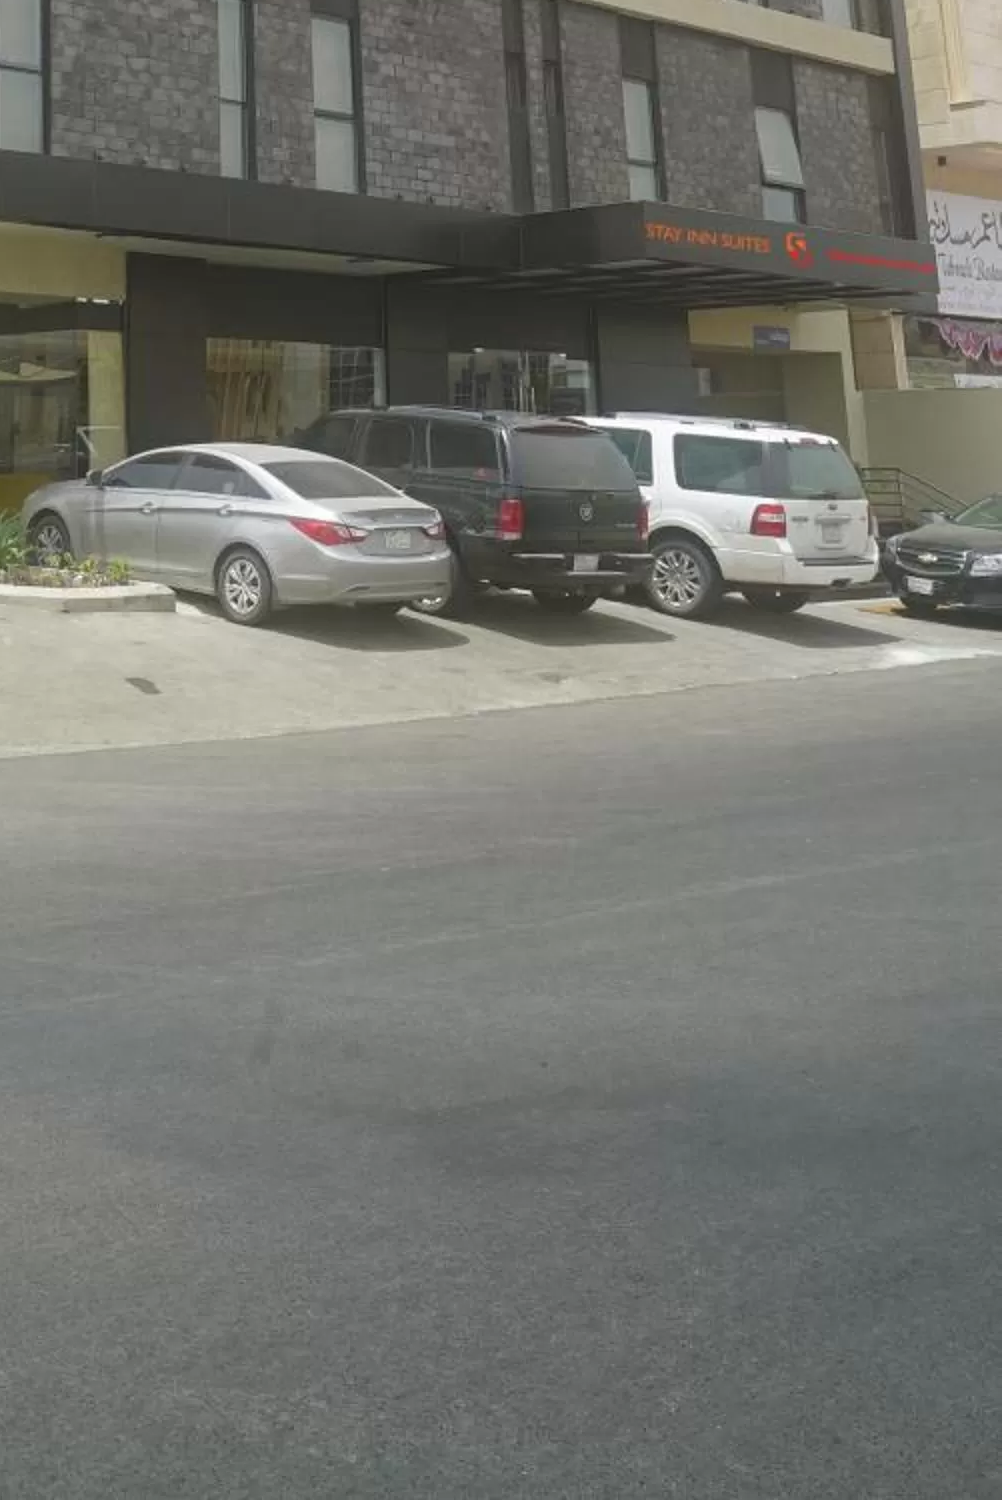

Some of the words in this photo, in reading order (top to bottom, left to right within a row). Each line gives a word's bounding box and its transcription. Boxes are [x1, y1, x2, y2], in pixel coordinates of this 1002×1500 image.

[645, 222, 682, 243] STAY
[685, 227, 718, 246] INN
[719, 232, 772, 254] SUITES
